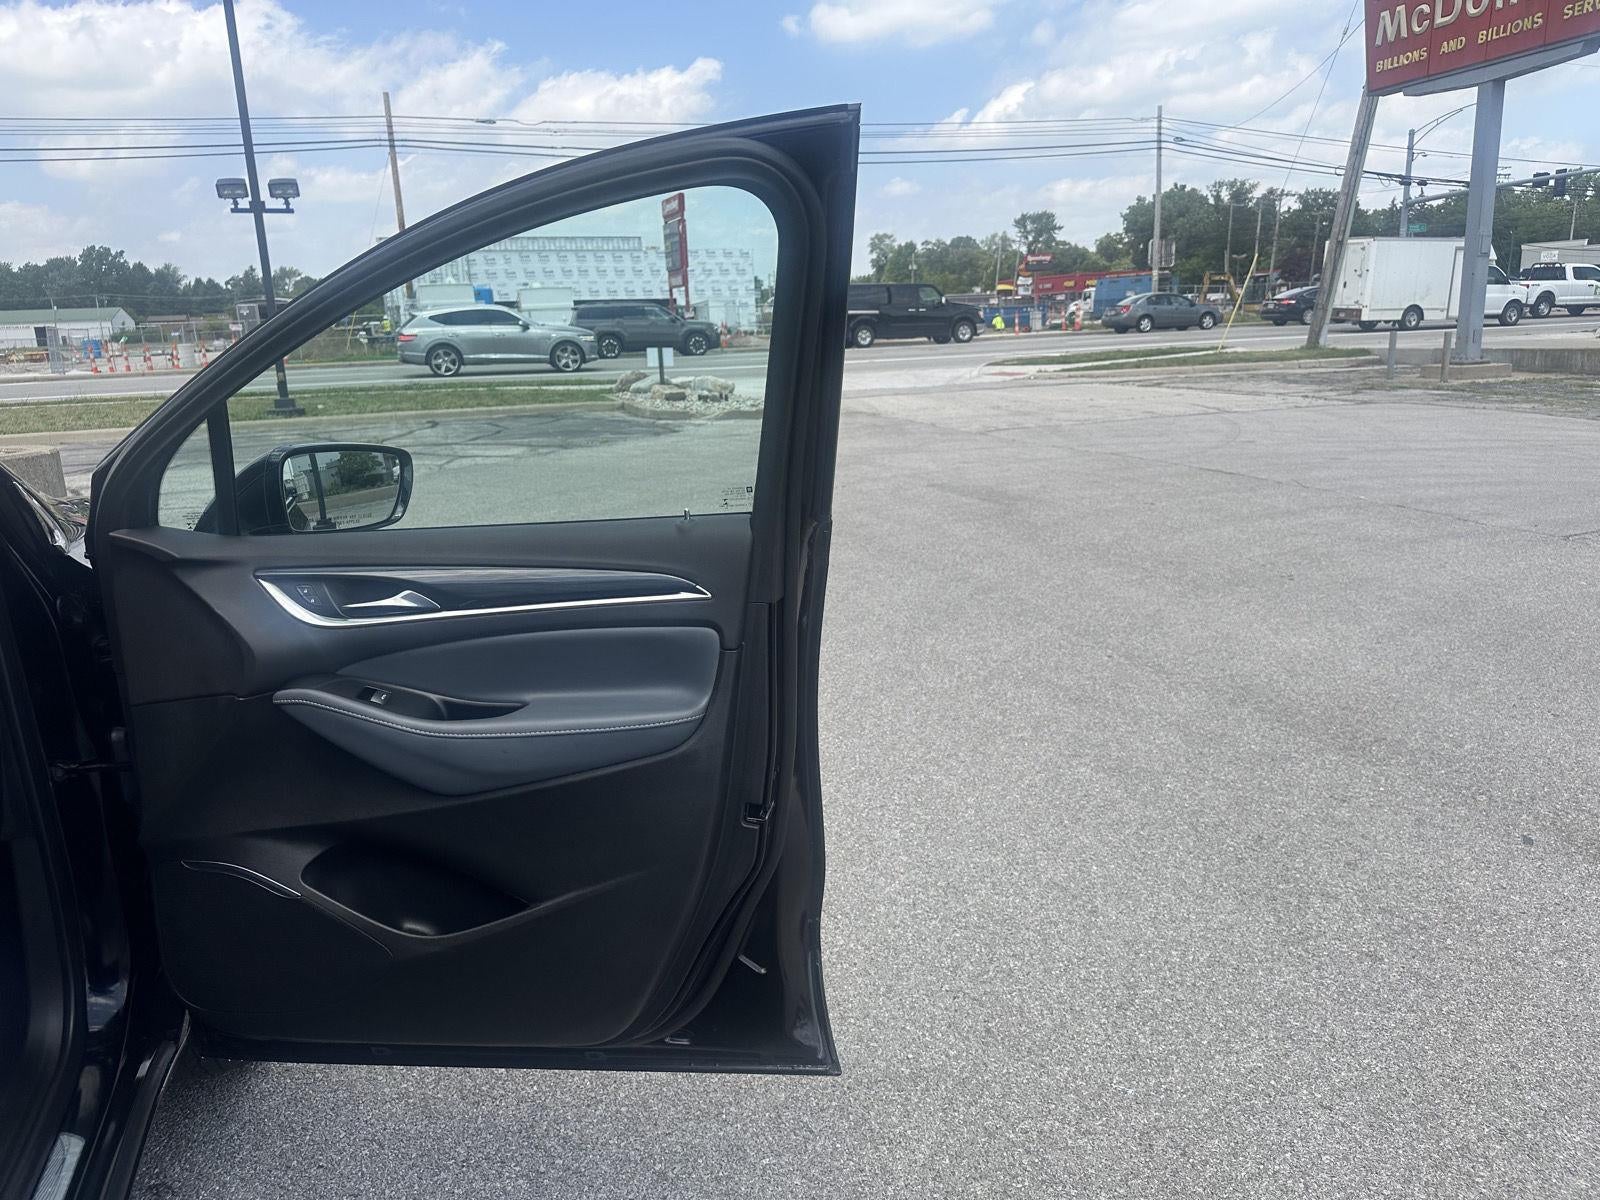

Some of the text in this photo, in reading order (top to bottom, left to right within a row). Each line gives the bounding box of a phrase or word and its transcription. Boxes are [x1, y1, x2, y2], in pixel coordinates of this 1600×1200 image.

[1375, 47, 1428, 73] BILLIONS
[1439, 36, 1466, 55] AND
[1477, 12, 1543, 44] BILLIONS
